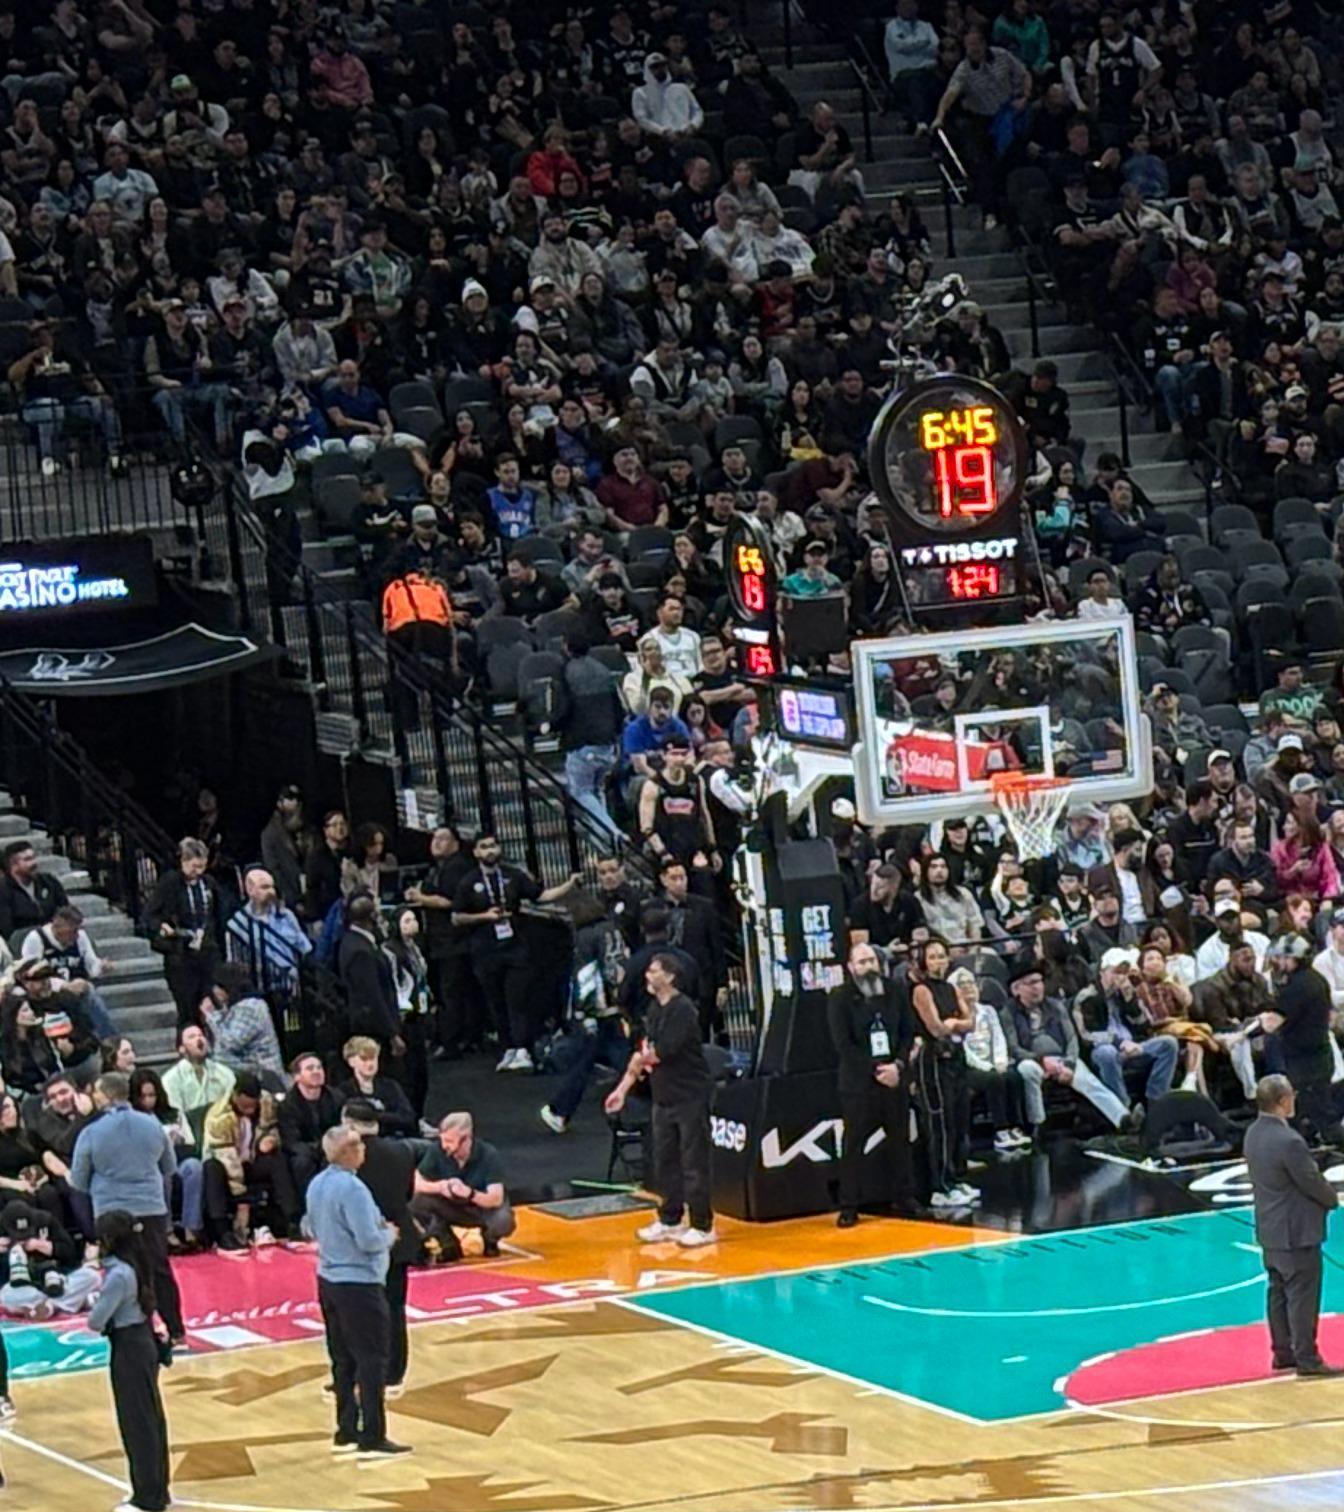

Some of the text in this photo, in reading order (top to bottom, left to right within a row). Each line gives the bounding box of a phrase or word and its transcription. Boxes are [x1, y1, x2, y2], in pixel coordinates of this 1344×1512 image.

[922, 408, 996, 449] 6:45
[937, 447, 997, 516] 19
[935, 538, 1018, 564] TISSOT
[0, 578, 128, 611] ASINO HOTEL
[806, 1223, 1190, 1286] CITY EDITION
